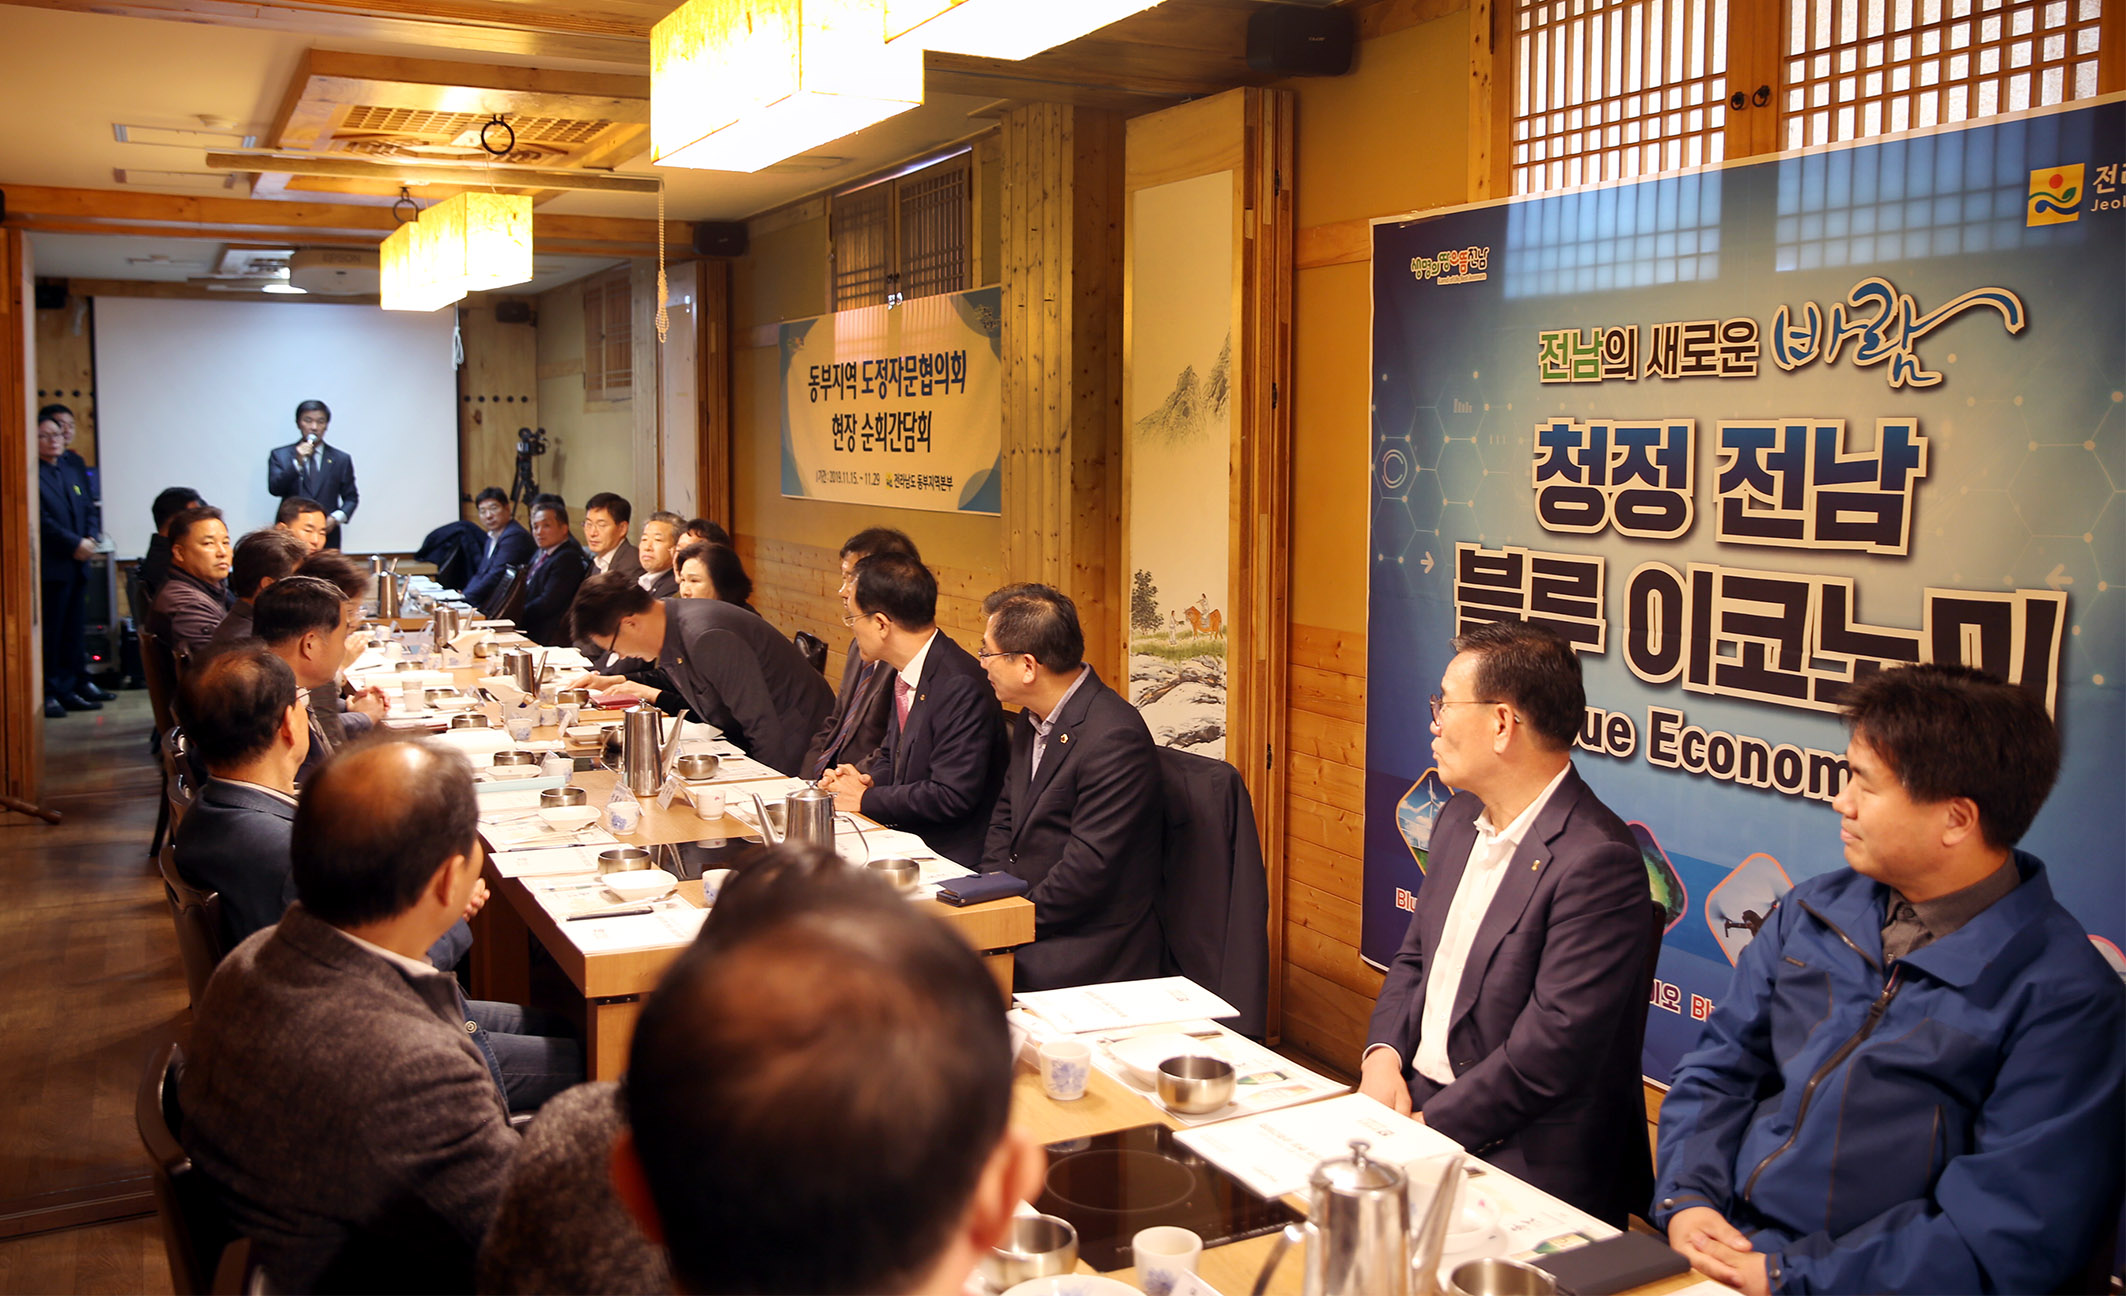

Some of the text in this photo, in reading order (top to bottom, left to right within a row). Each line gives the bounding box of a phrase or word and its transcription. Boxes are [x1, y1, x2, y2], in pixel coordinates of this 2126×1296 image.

[2092, 163, 2126, 194] 전
[1538, 276, 2026, 388] 전남의 새로운 바람
[808, 350, 967, 403] 동부지역 도정자문협의회
[832, 410, 932, 453] 현장 순회간담회
[1532, 417, 1928, 556] 청정 전남
[1571, 704, 1852, 803] ue Econom
